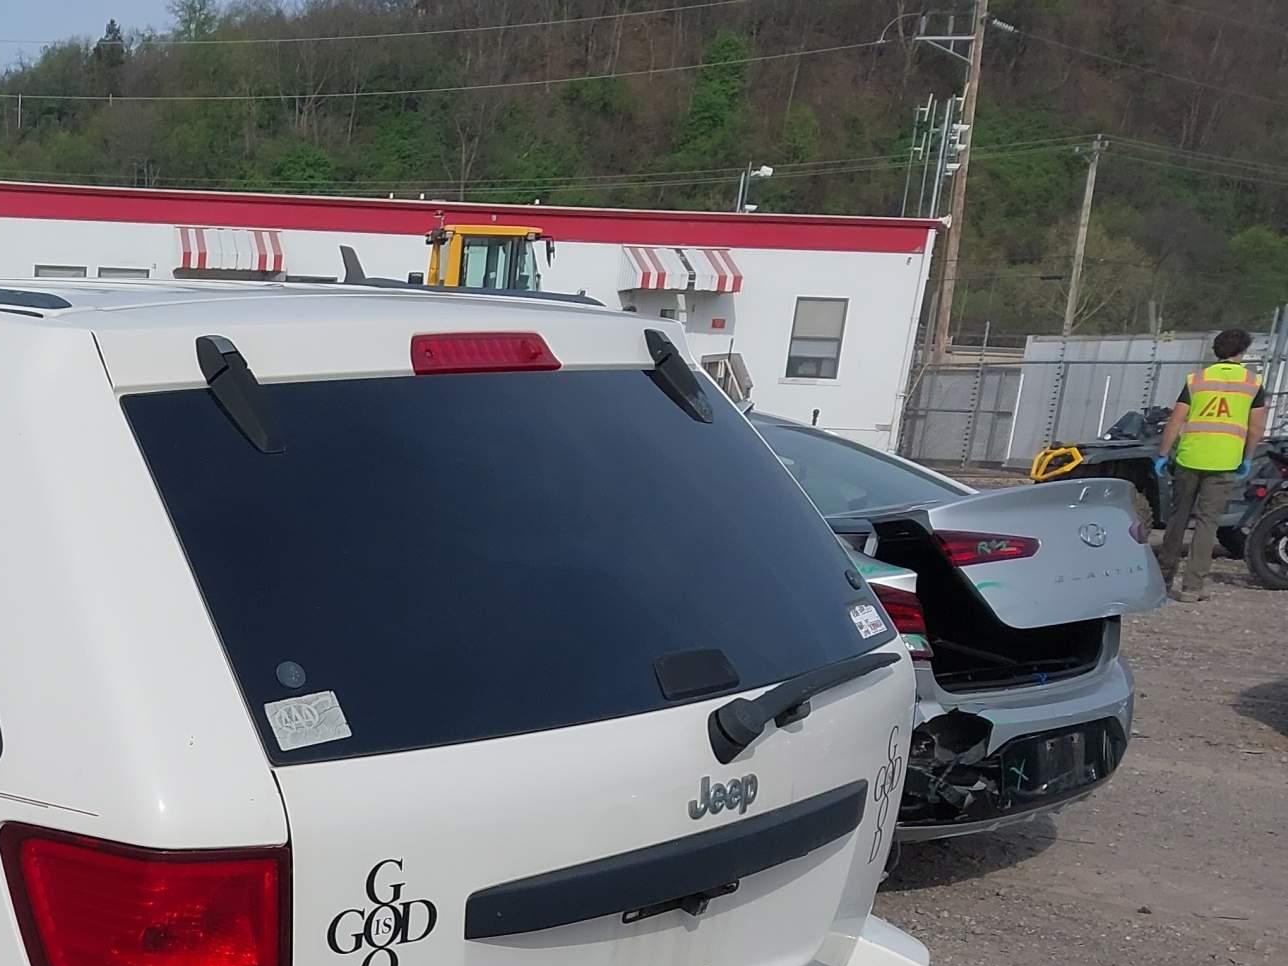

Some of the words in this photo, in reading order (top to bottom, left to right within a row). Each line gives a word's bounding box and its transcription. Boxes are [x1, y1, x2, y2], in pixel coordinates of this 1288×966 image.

[688, 773, 758, 820] Jeep
[327, 899, 438, 954] GOD
[374, 918, 392, 936] IS
